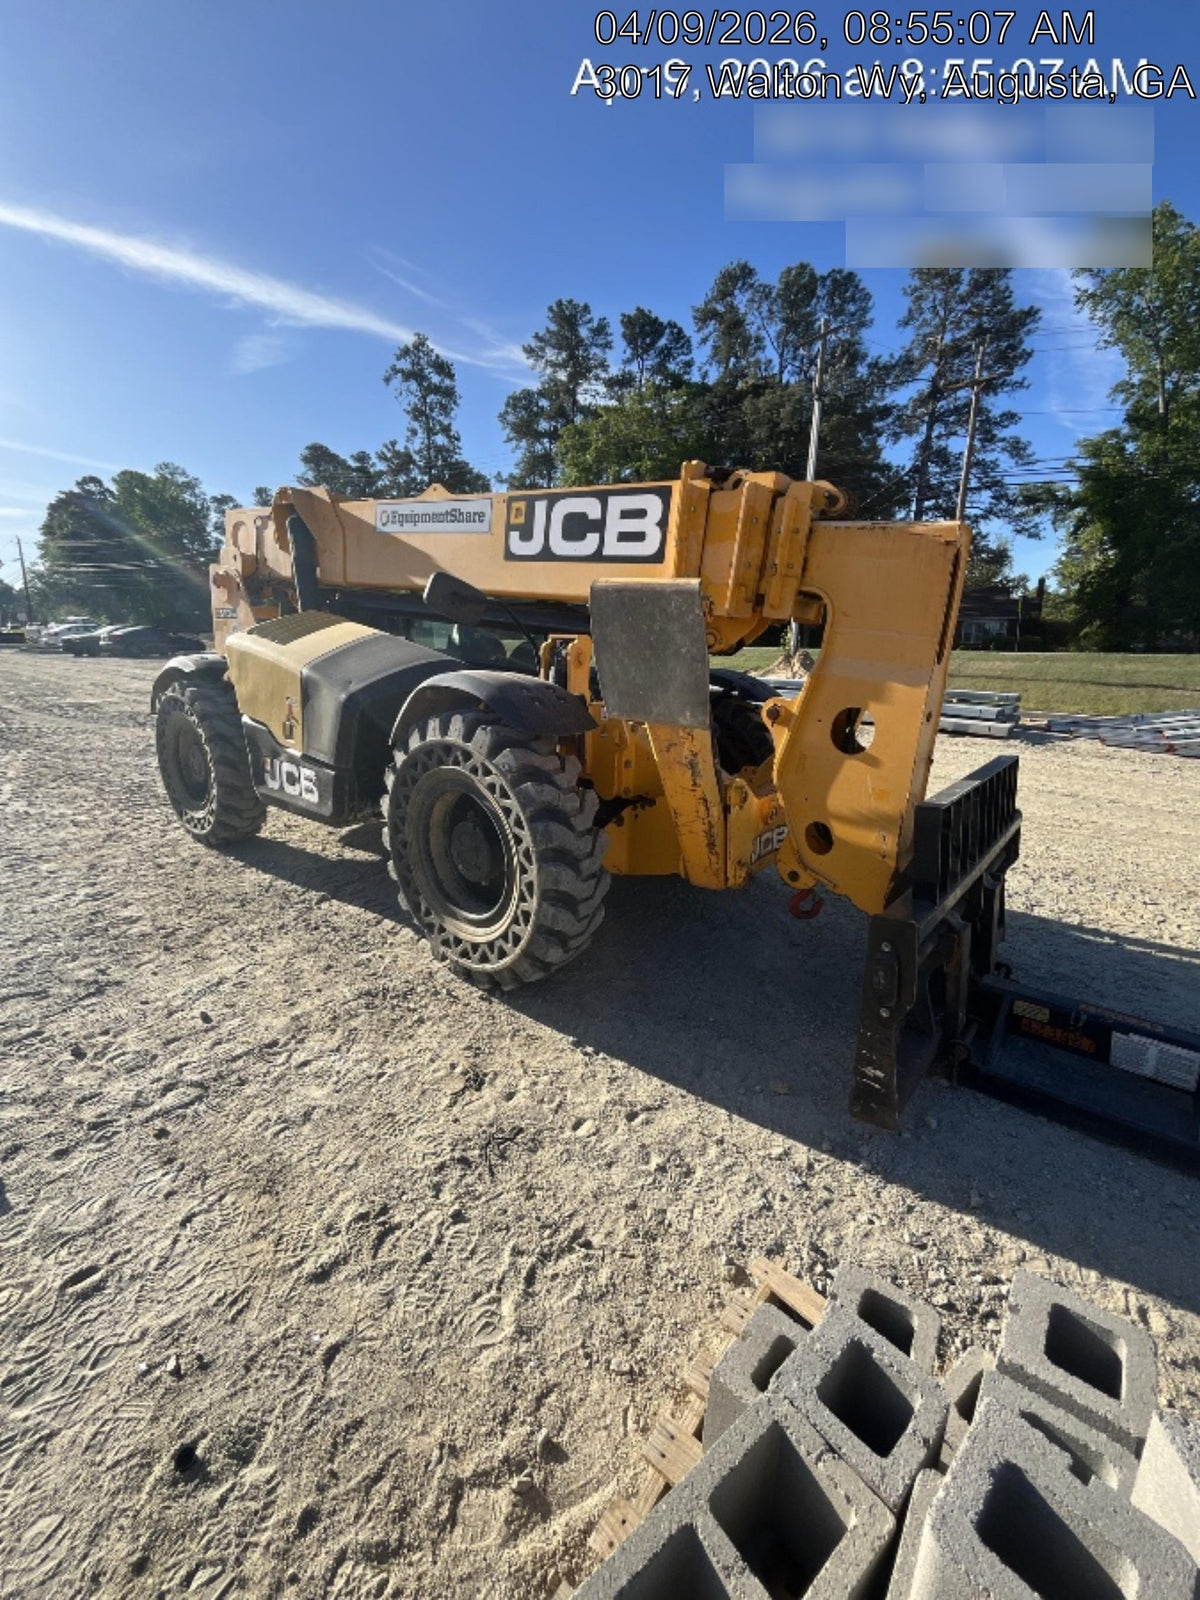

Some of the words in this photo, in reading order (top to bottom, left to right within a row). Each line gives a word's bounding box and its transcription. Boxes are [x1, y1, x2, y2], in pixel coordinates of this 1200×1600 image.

[389, 507, 486, 528] EquipmentShare
[508, 493, 664, 557] JCB
[263, 757, 319, 804] JCB
